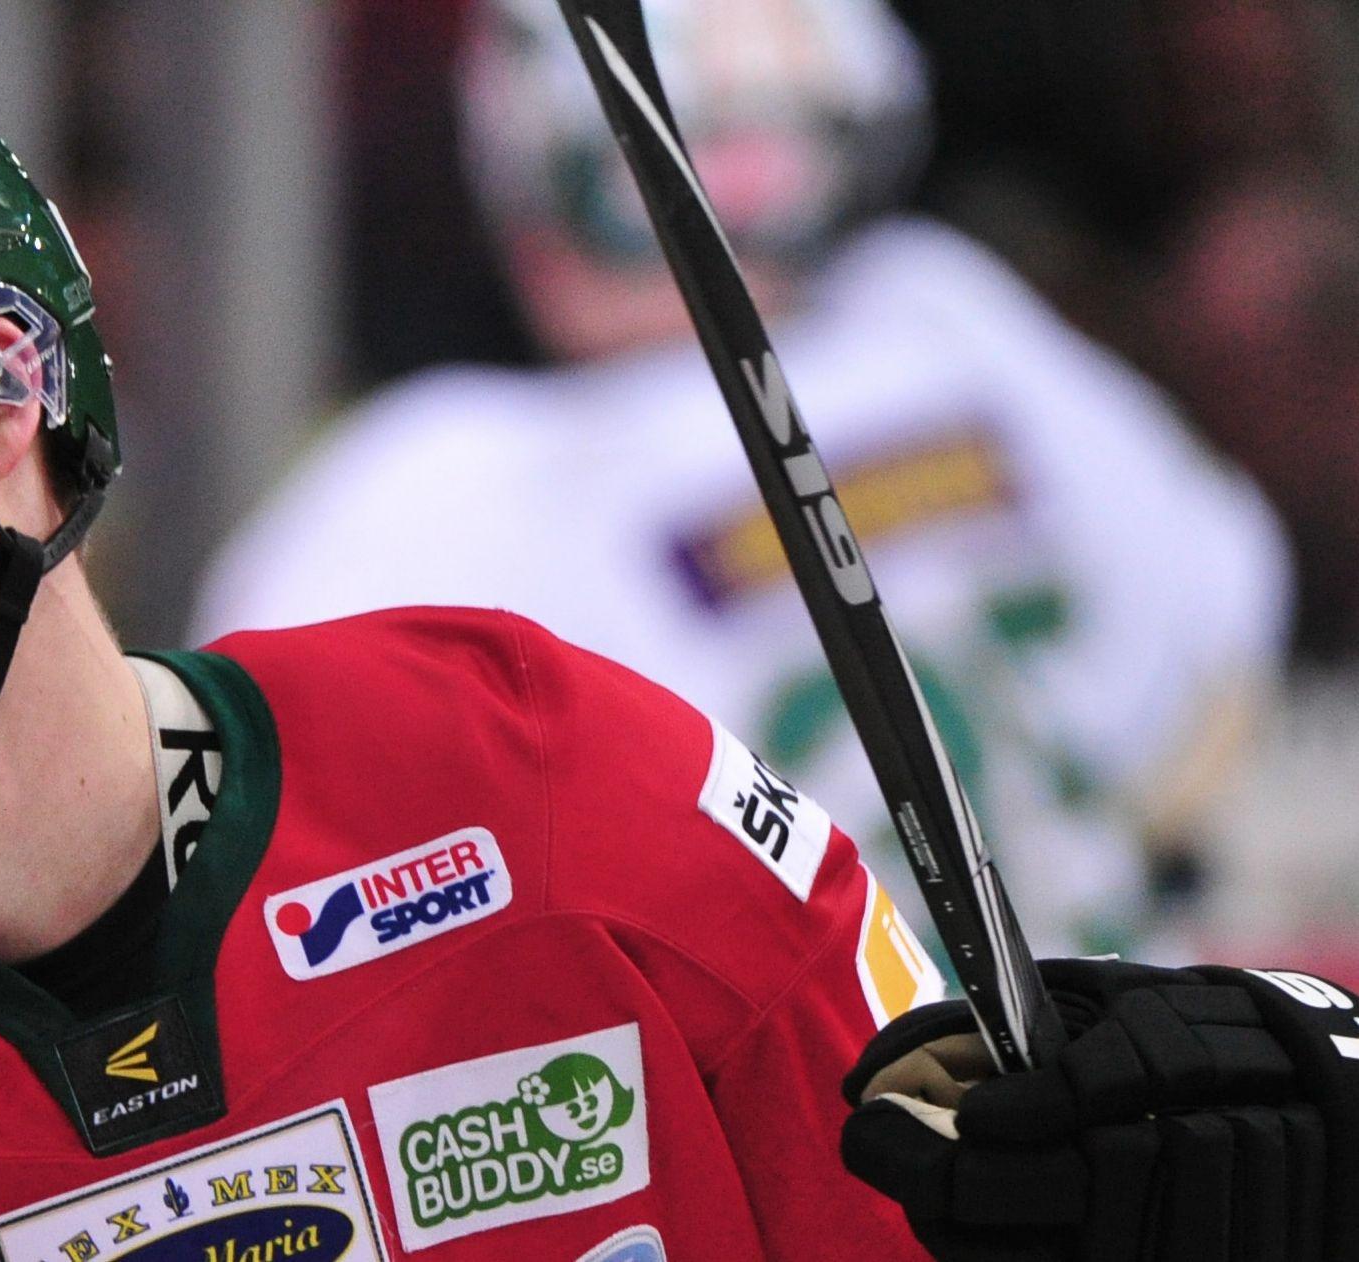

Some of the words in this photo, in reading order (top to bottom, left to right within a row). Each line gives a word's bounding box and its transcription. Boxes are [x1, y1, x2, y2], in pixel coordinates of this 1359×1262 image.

[360, 840, 484, 910] INTER
[370, 873, 492, 945] SPORT
[93, 1074, 198, 1127] EASTON
[406, 1105, 529, 1174] CASH
[39, 1202, 151, 1262] EX
[207, 1164, 346, 1207] MEX
